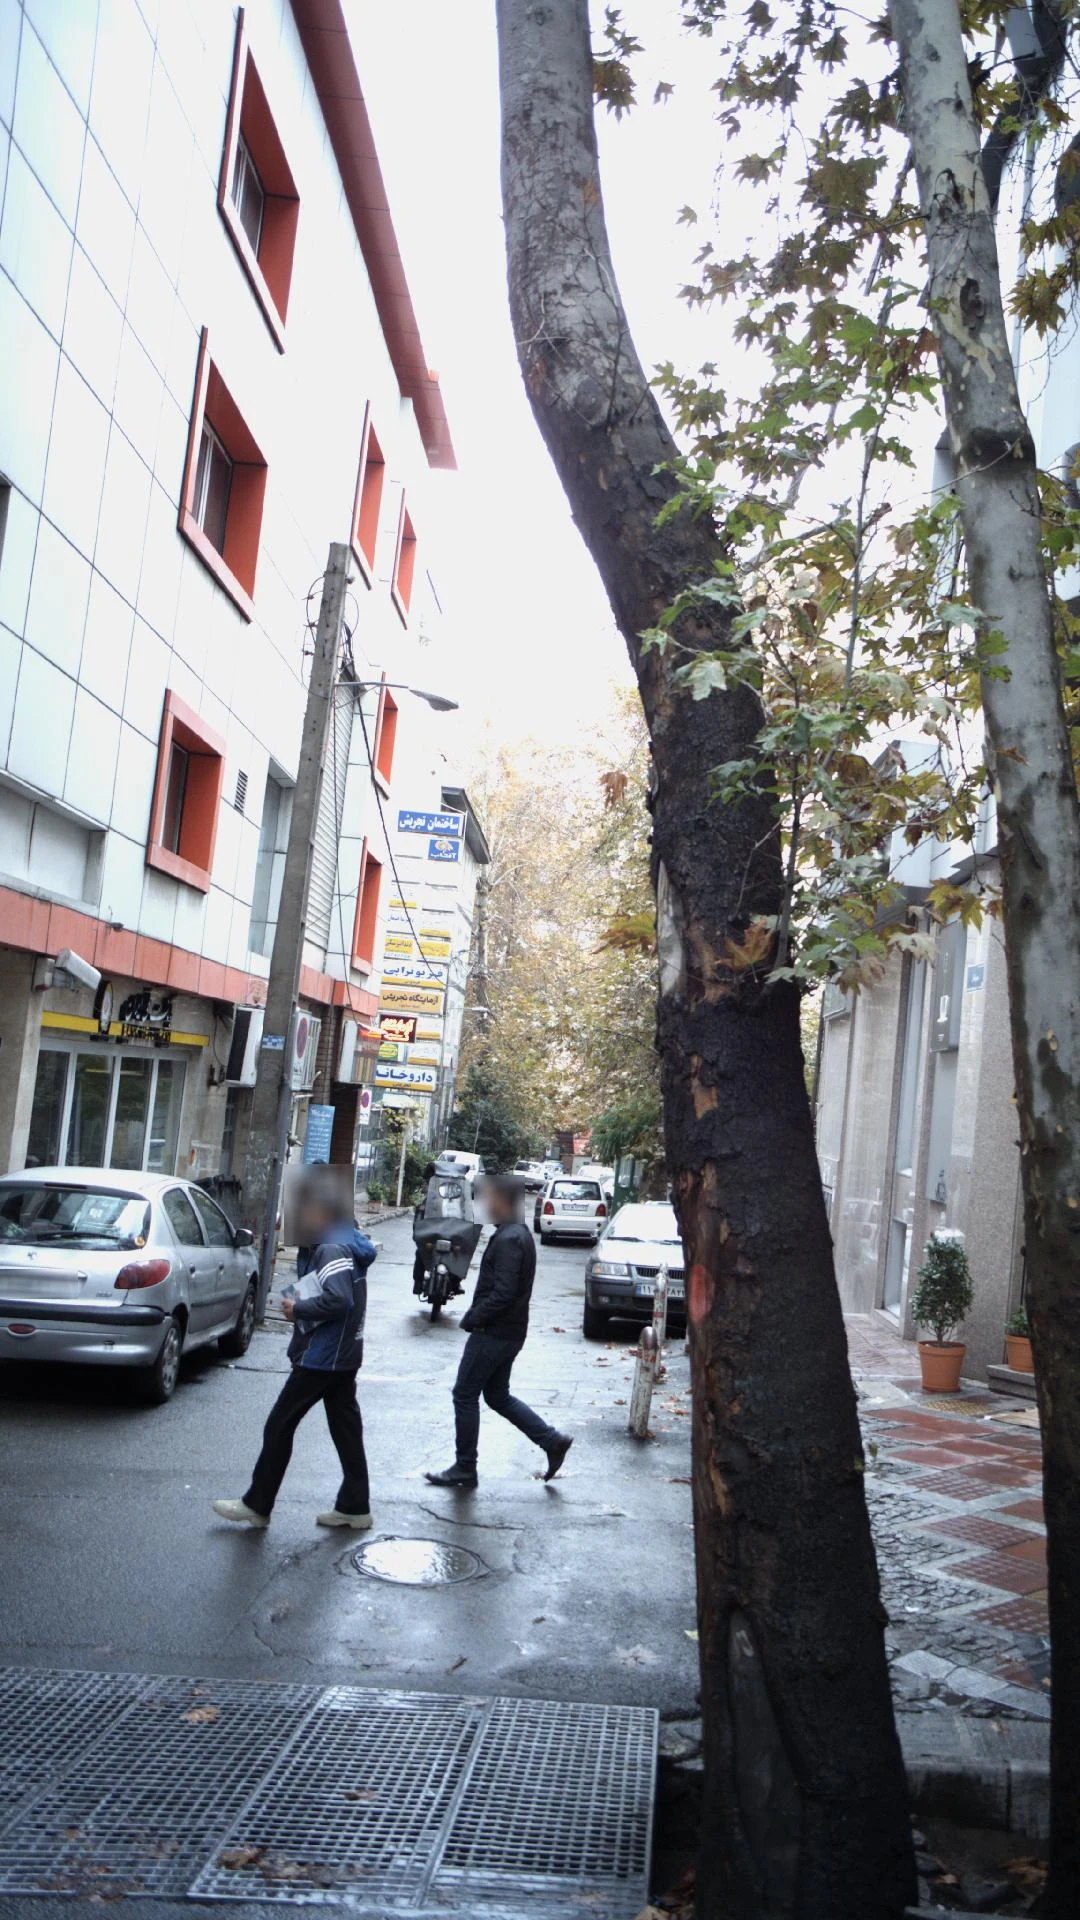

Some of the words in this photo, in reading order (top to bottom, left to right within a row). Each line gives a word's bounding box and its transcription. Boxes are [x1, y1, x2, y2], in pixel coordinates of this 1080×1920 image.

[399, 813, 427, 830] تجریش
[427, 816, 459, 831] ساختمان
[382, 993, 408, 1002] تجریش
[409, 995, 439, 1005] آزمایشگاه
